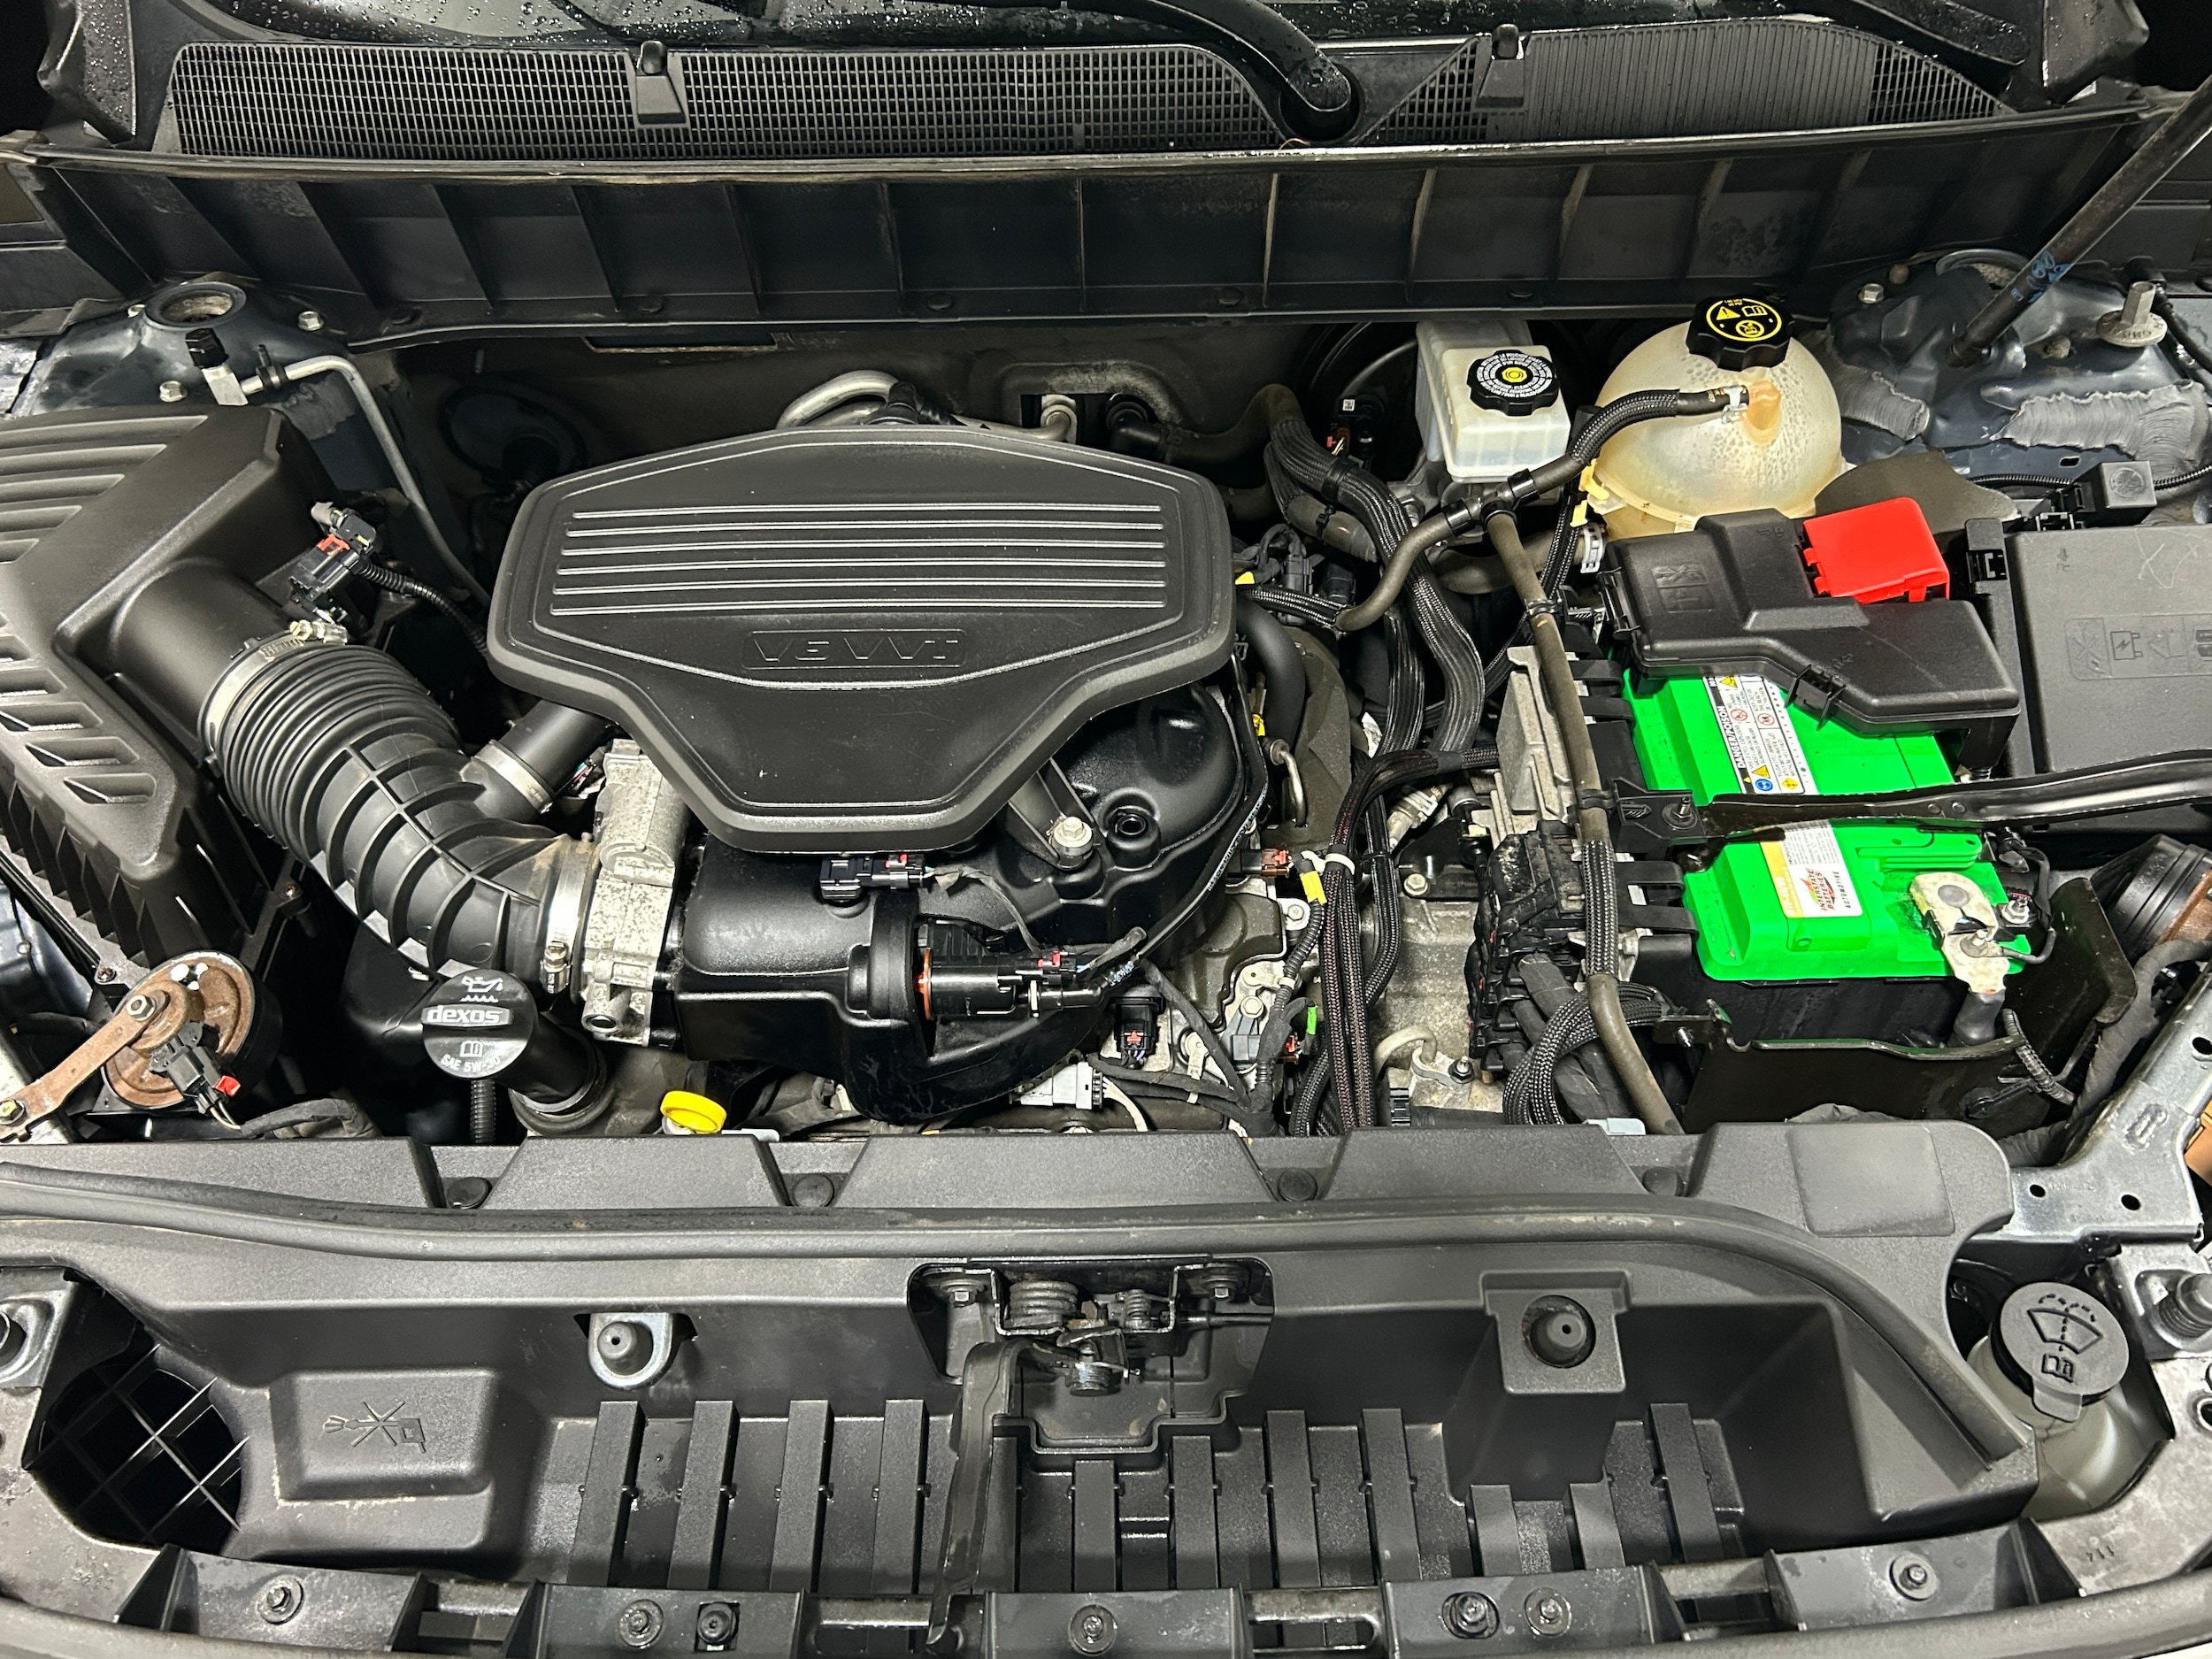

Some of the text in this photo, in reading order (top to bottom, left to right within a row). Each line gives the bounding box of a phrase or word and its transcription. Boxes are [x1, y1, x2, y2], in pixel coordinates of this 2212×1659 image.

[842, 635, 959, 660] VVT
[1717, 705, 1747, 769] DANGER/POISON
[1807, 868, 1828, 911] INTERSTATE
[1816, 872, 1835, 910] BATTERIES
[1832, 870, 1851, 909] AUTOMOTIVE
[426, 1004, 503, 1024] dexos
[441, 1054, 502, 1072] SAE 5W-30
